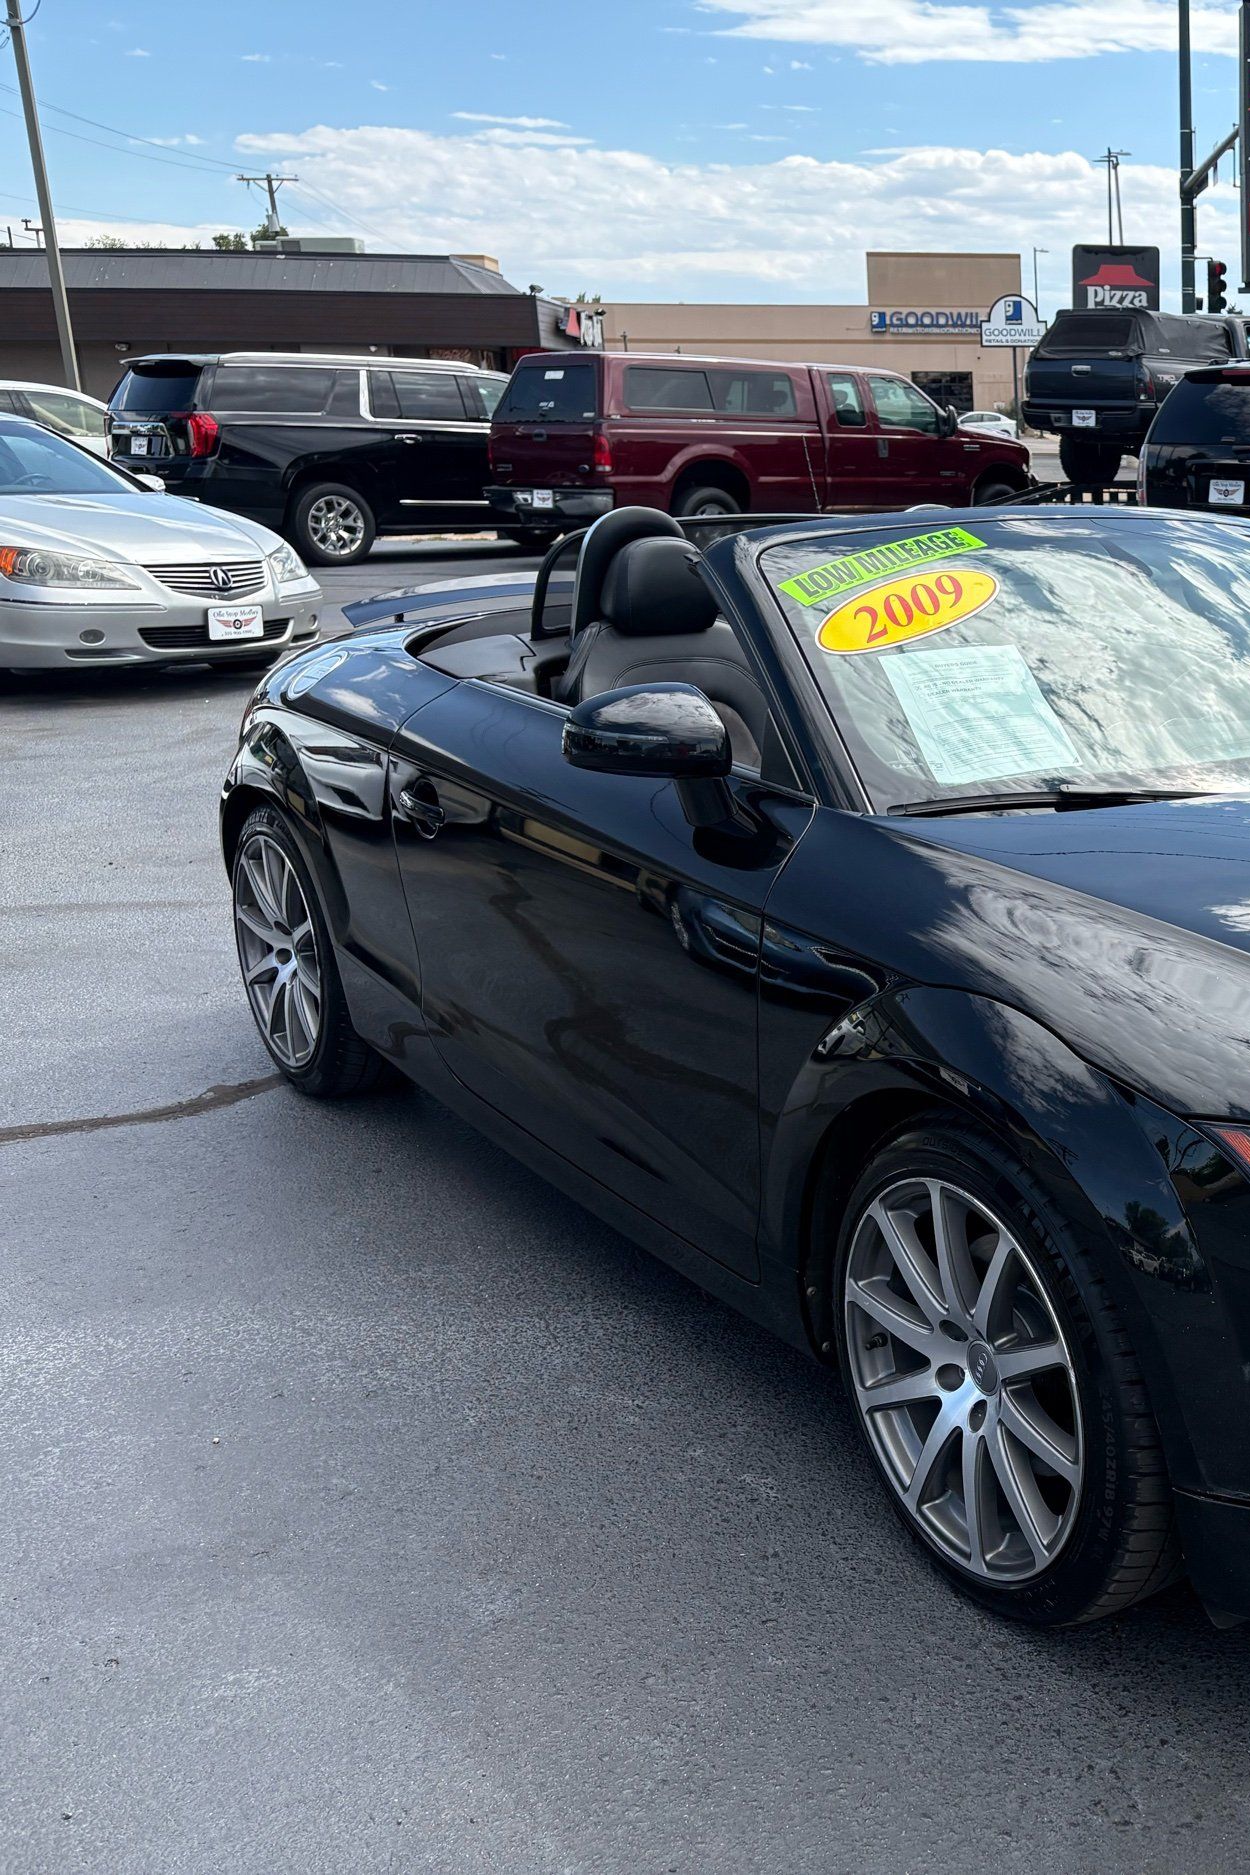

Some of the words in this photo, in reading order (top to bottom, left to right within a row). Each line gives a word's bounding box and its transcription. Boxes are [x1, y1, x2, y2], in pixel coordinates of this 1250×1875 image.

[1086, 284, 1148, 309] Pizza
[889, 311, 980, 328] GOODWIL
[984, 328, 1043, 337] GOODWILL
[793, 560, 860, 598] LOW
[852, 530, 967, 575] MILEAGE
[854, 574, 963, 643] 2009
